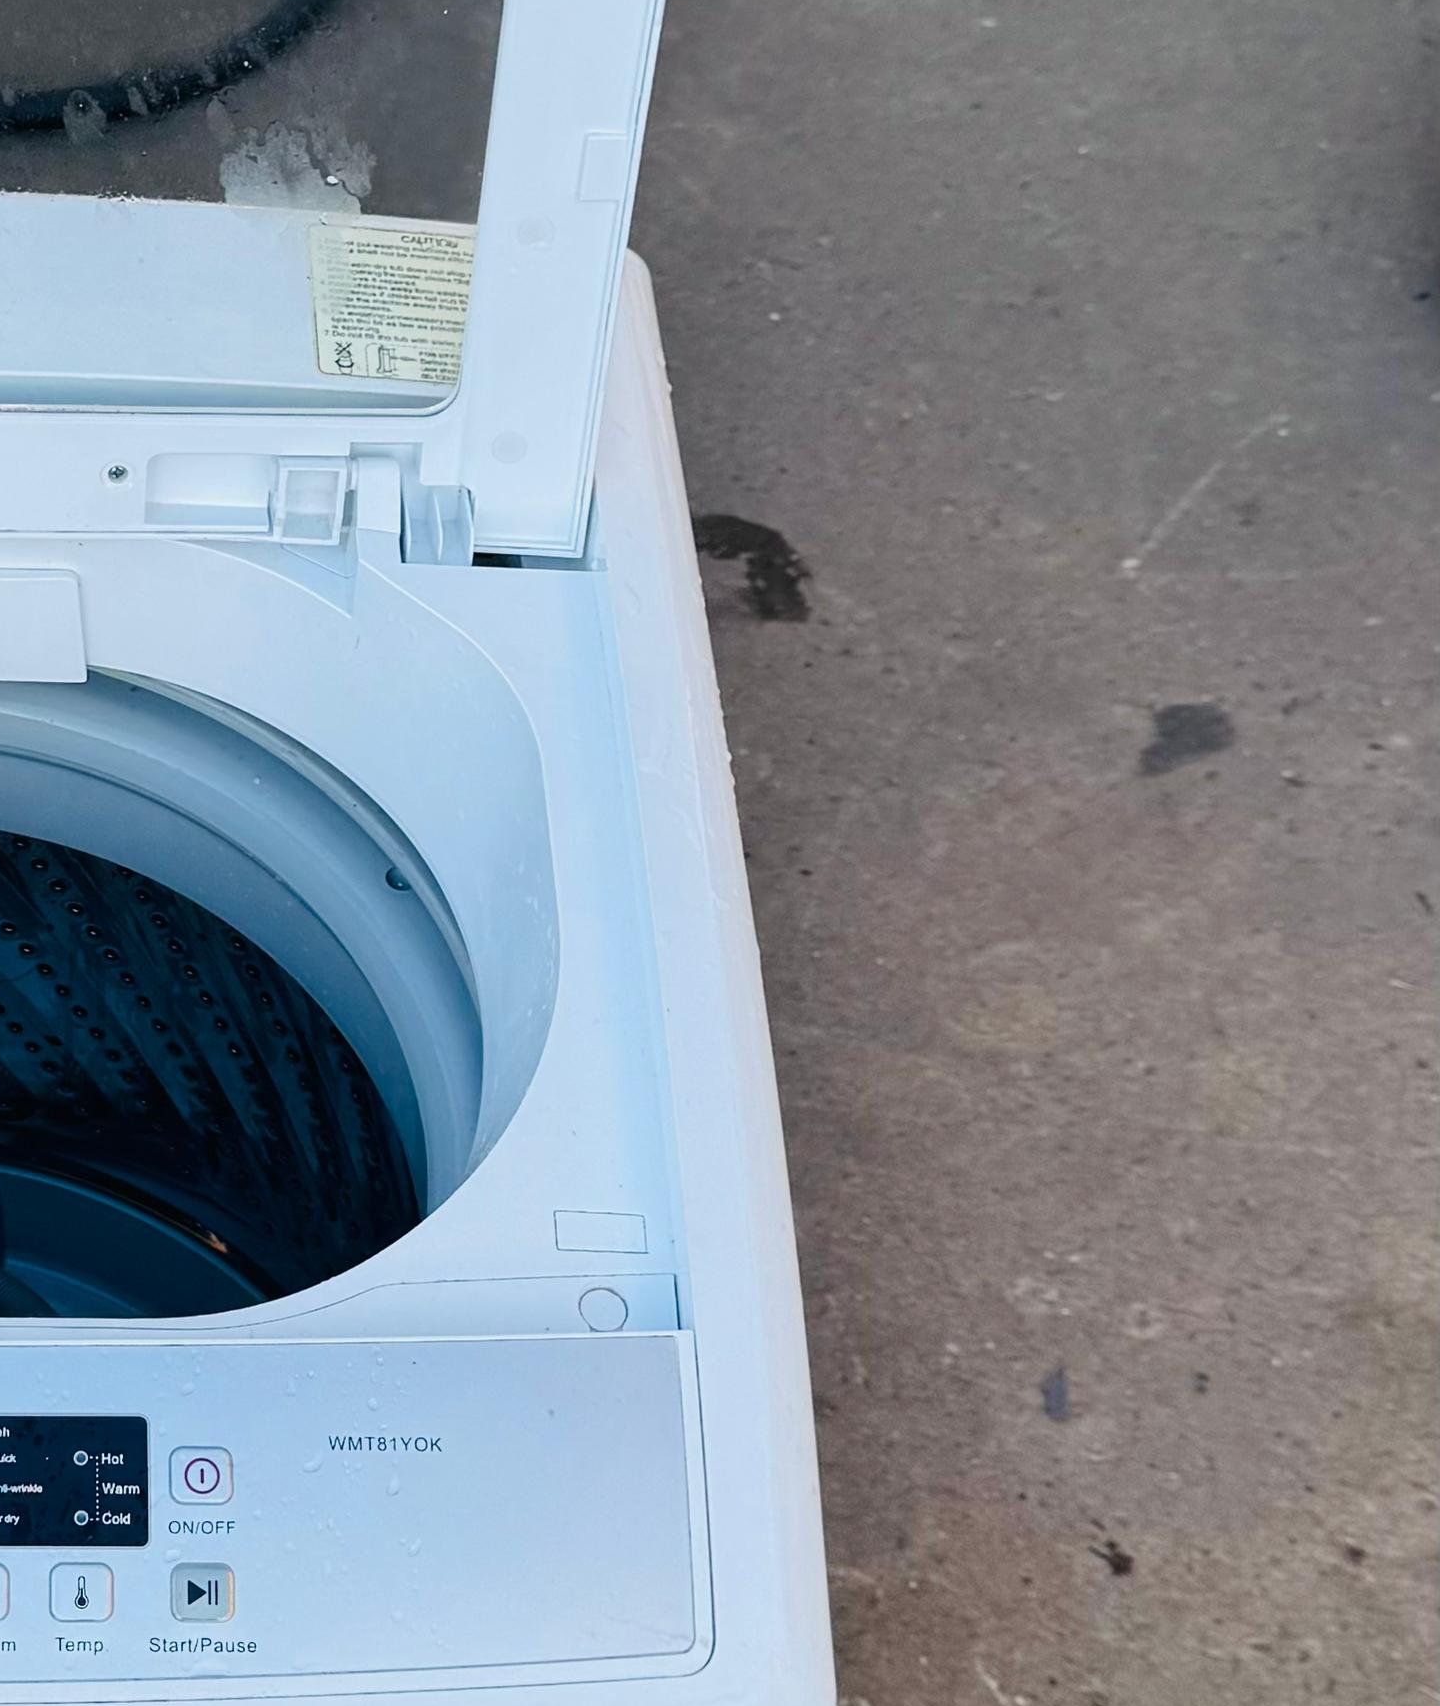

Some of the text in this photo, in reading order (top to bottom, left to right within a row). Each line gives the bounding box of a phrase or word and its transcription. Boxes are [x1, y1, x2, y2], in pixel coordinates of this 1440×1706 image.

[328, 1435, 443, 1453] WMT81YOK
[101, 1453, 124, 1465] Hot
[101, 1483, 141, 1495] Warm
[102, 1512, 131, 1525] Cold
[168, 1520, 236, 1535] ON/OFF
[149, 1637, 258, 1654] Start/Pause
